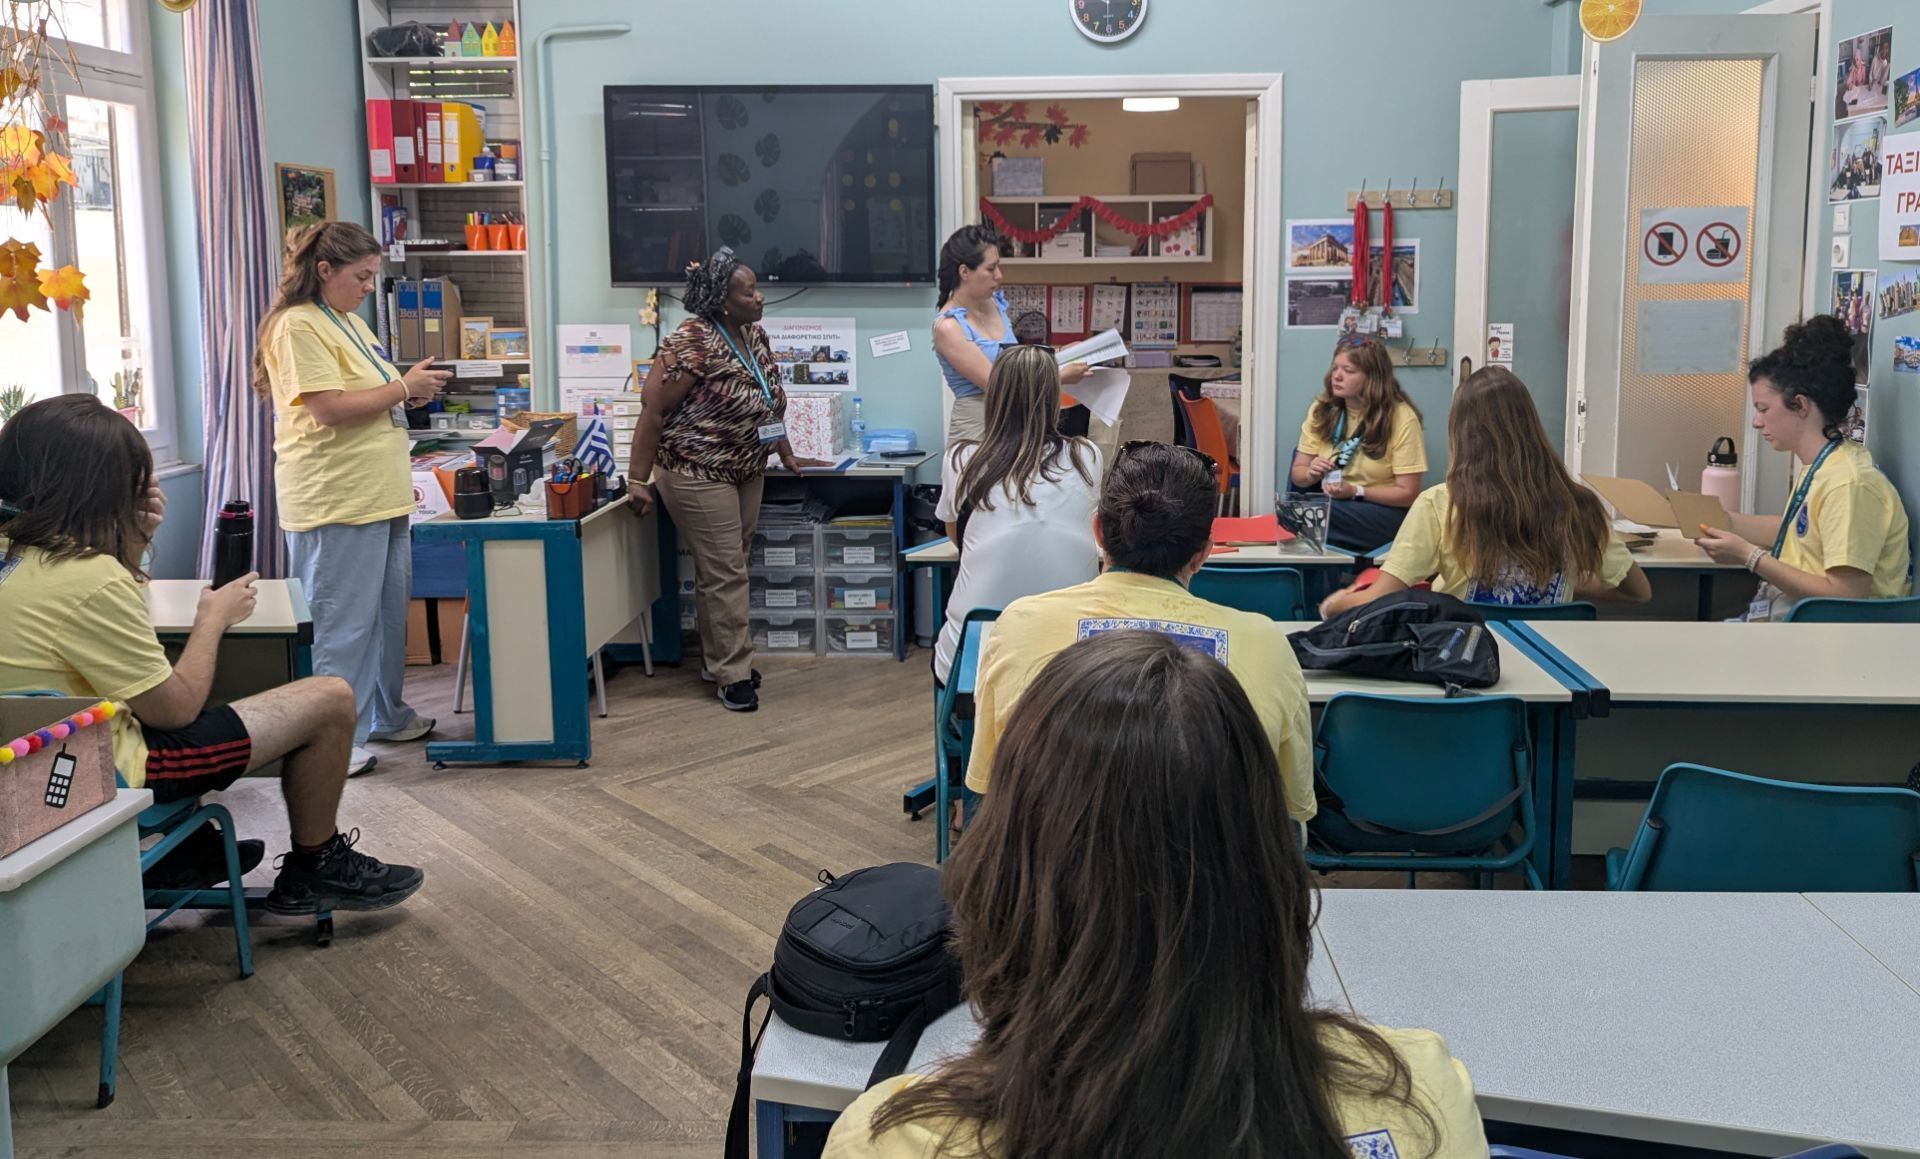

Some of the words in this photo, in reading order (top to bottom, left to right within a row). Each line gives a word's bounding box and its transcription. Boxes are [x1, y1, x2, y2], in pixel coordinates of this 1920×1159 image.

[1083, 13, 1089, 22] 8
[1127, 9, 1134, 18] 4
[1093, 21, 1100, 31] 7
[1105, 24, 1112, 33] 6
[1118, 20, 1125, 29] 5
[1886, 150, 1920, 176] ΤΑΞΙ
[399, 308, 418, 318] Box
